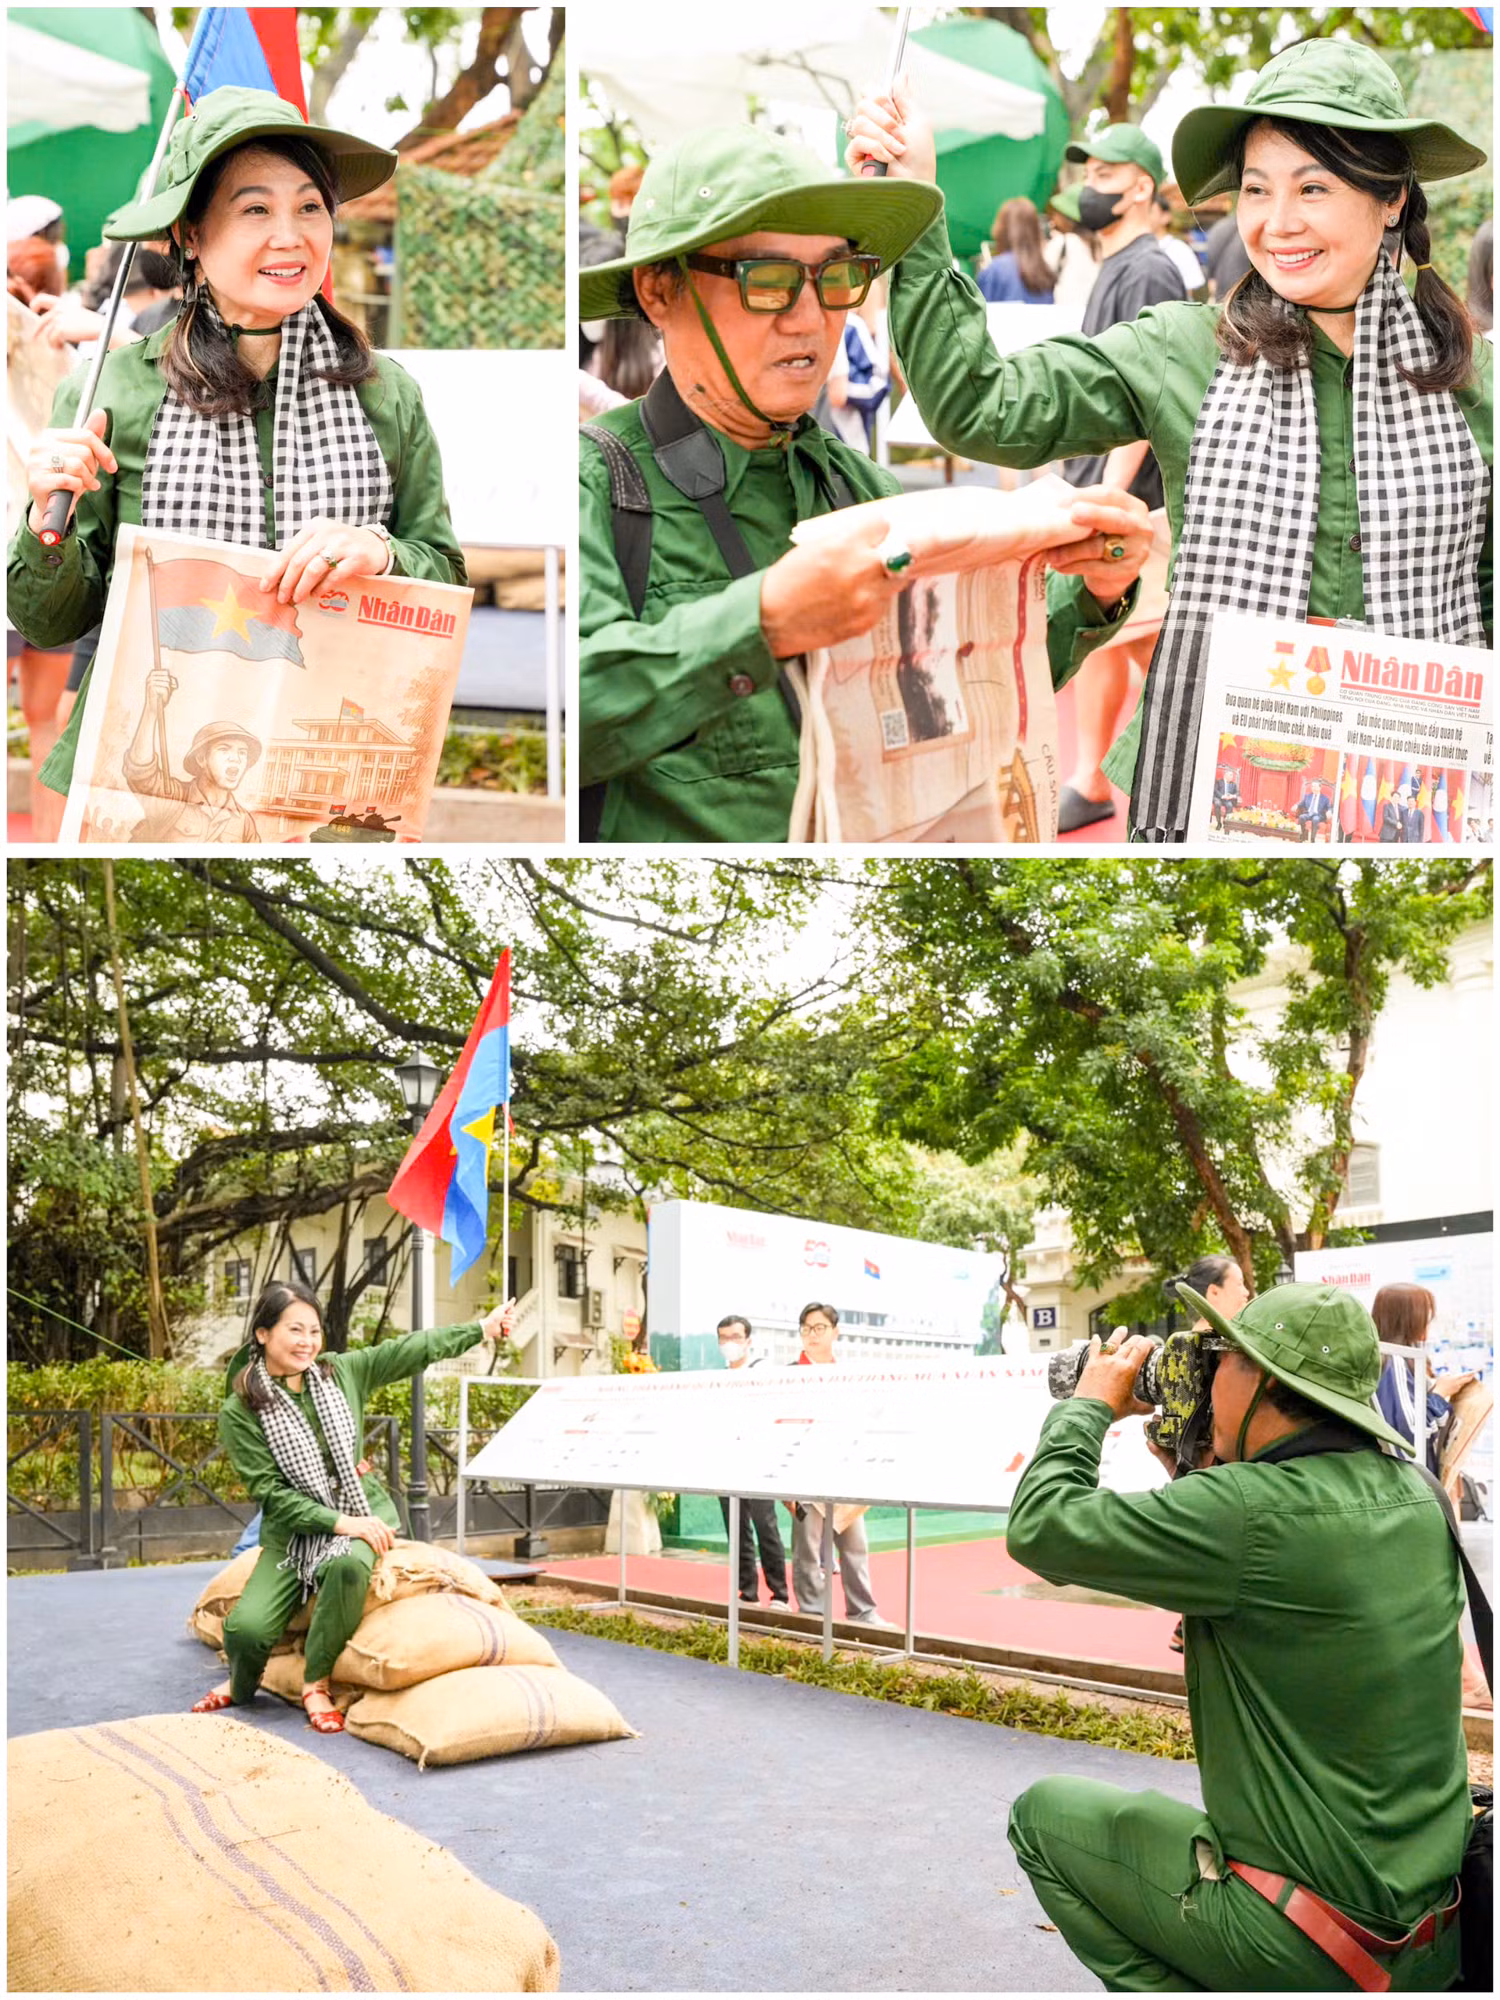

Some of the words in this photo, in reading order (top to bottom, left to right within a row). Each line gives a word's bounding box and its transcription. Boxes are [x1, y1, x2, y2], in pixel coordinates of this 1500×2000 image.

[358, 595, 415, 626] Nhân
[415, 606, 456, 634] Dân
[1341, 650, 1420, 691] Nhân
[1423, 661, 1484, 700] Dân
[1231, 711, 1240, 725] và
[1240, 714, 1248, 727] EU
[1262, 713, 1278, 731] triển
[1277, 720, 1291, 736] thực
[1306, 723, 1320, 741] hiệu
[1320, 724, 1333, 740] quả
[1237, 696, 1252, 709] quan
[1252, 696, 1260, 712] hệ
[1260, 697, 1274, 713] giữa
[1273, 699, 1286, 716] Việt
[1286, 703, 1299, 716] Nam
[1300, 704, 1310, 717] với
[1310, 706, 1343, 723] Philippines
[1357, 710, 1369, 726] Dấu
[1369, 712, 1382, 728] mốc
[1382, 718, 1396, 732] quan
[1396, 719, 1414, 736] trọng
[1414, 722, 1428, 735] thúc
[1428, 720, 1440, 739] đẩy
[1439, 727, 1455, 740] quan
[1454, 727, 1463, 743] hệ
[1346, 729, 1359, 746] Việt
[1386, 737, 1392, 749] đi
[1404, 736, 1422, 754] chiều
[1421, 741, 1432, 756] sâu
[1432, 743, 1441, 757] và
[1440, 742, 1455, 759] thiết
[1455, 747, 1468, 763] thực
[1036, 1309, 1053, 1326] B
